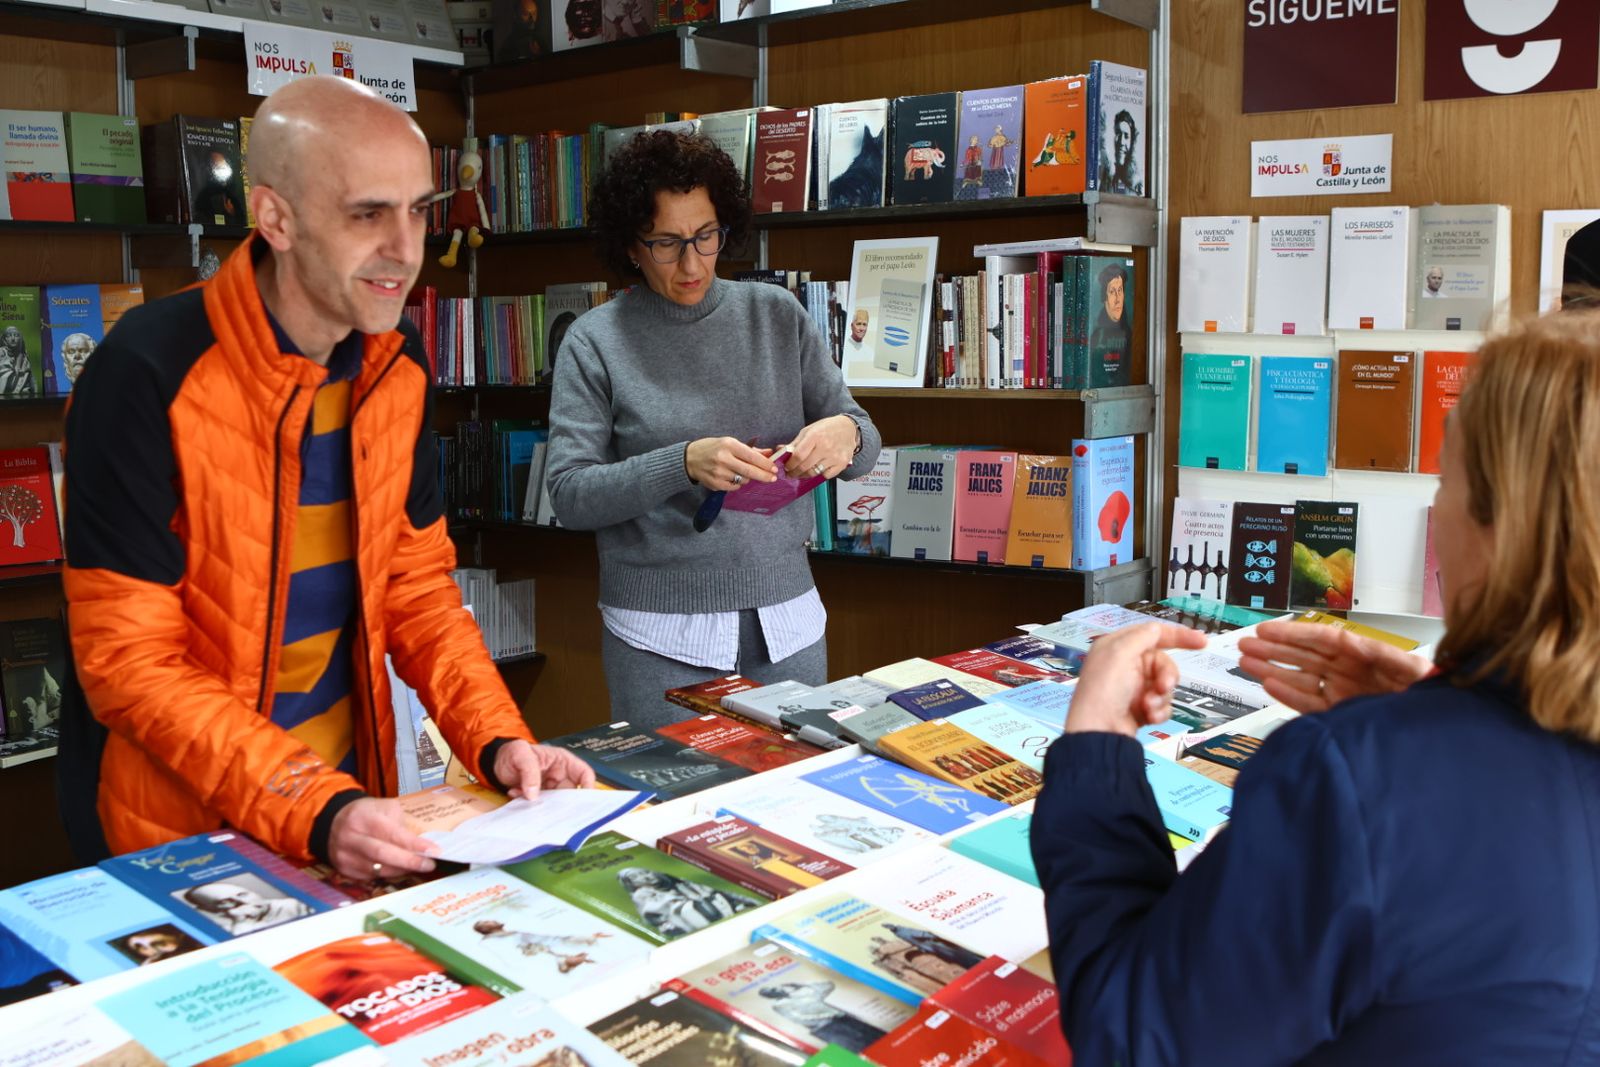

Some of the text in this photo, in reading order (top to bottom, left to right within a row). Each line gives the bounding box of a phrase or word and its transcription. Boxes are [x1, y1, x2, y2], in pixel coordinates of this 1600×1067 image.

[254, 42, 279, 54] NOS
[359, 74, 405, 89] Junta de
[9, 132, 59, 141] llamada divina
[28, 124, 58, 134] humano,
[102, 128, 108, 136] El
[1258, 155, 1278, 164] NOS
[1343, 165, 1386, 175] Junta de
[1316, 175, 1386, 188] Castilla y León
[1344, 220, 1394, 230] LOS FARISEOS
[1285, 229, 1316, 237] MUJERES
[869, 263, 880, 272] por
[51, 296, 90, 305] Sócrates
[4, 457, 37, 468] La Biblia
[909, 462, 943, 477] FRANZ
[969, 462, 1003, 477] FRANZ
[1030, 466, 1070, 481] FRANZ
[908, 477, 943, 492] JALICS
[968, 478, 1002, 493] JALICS
[1026, 482, 1067, 497] JALICS
[1184, 520, 1224, 530] Cuatro actos
[1300, 513, 1328, 522] ANSELM
[1184, 528, 1224, 538] de presencia
[1239, 523, 1271, 531] PEREGRINO
[1339, 525, 1353, 533] bien
[1331, 533, 1353, 541] mismo
[411, 892, 457, 913] Santo
[432, 884, 508, 917] Domingo
[909, 889, 957, 912] Escuela
[931, 891, 995, 921] Salamanca
[764, 955, 793, 971] eco
[718, 961, 756, 982] grito
[336, 971, 447, 1018] TOCADOS
[365, 1001, 400, 1019] POR
[399, 979, 463, 1007] DIOS
[975, 1000, 1011, 1023] Sobre
[996, 988, 1056, 1032] el matrimonio
[422, 1031, 507, 1066] Imagen
[507, 1029, 556, 1054] obra
